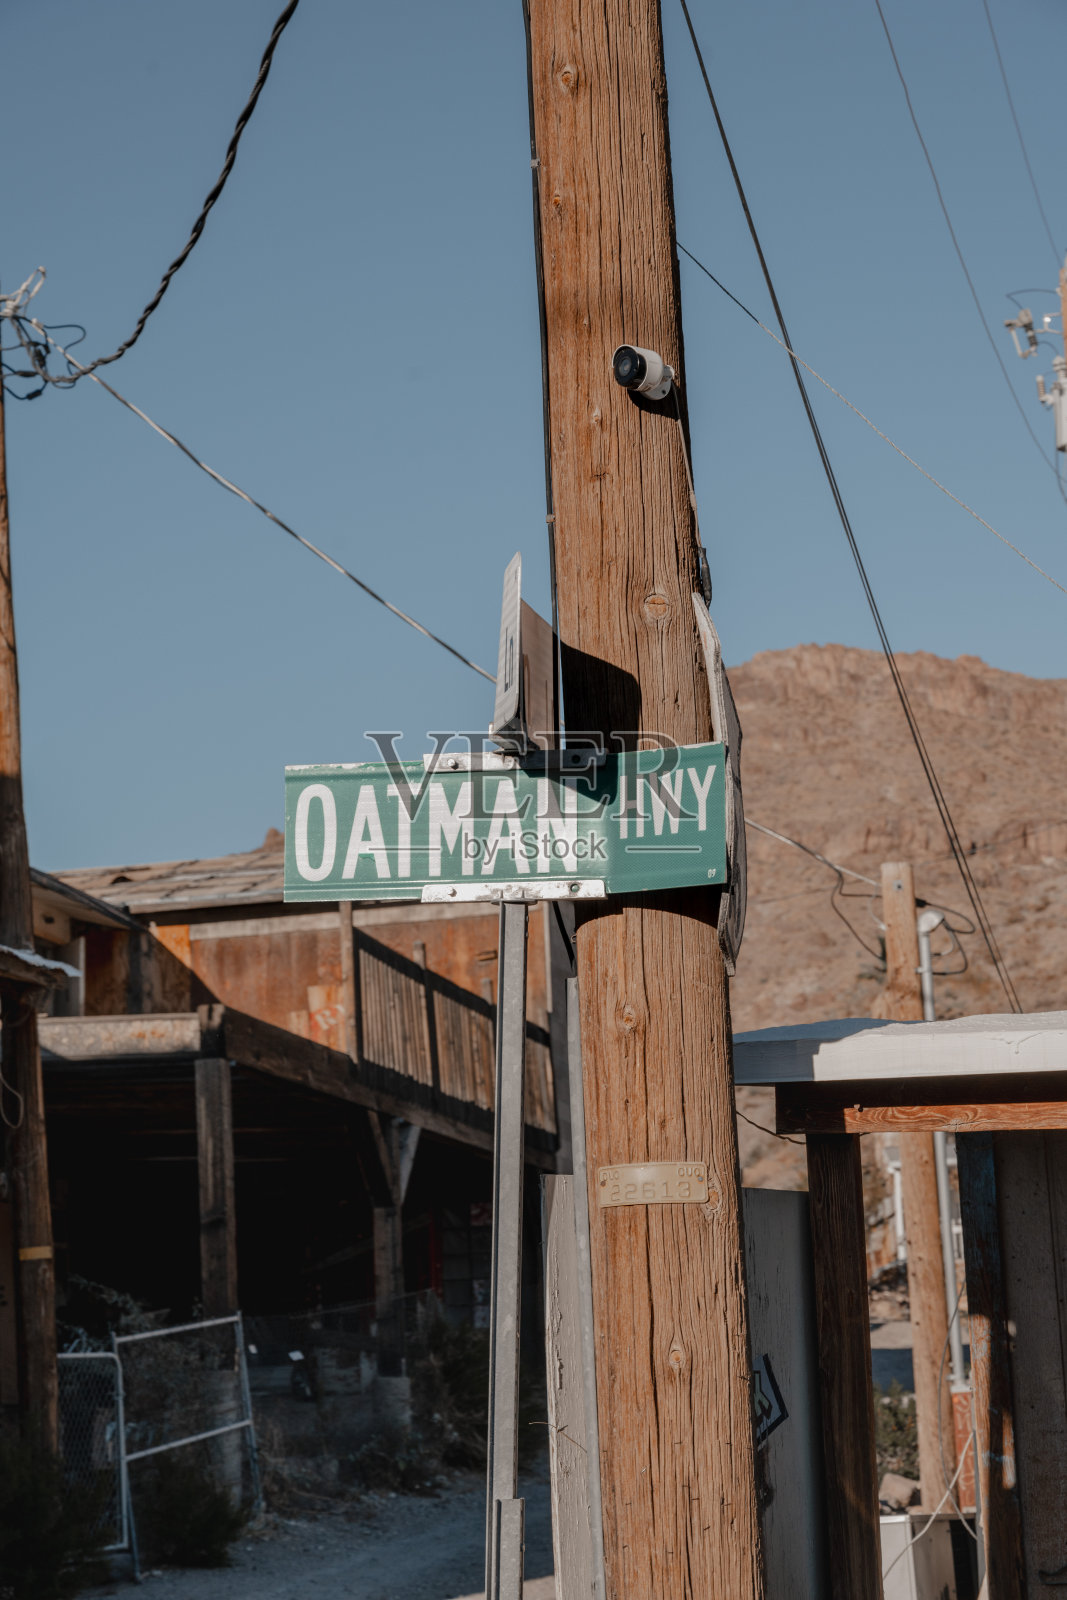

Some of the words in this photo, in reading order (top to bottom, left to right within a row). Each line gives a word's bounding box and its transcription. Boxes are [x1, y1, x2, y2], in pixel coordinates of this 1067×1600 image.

[294, 779, 579, 882] OATMAN
[618, 764, 718, 840] HWY
[610, 1180, 691, 1202] 22613
